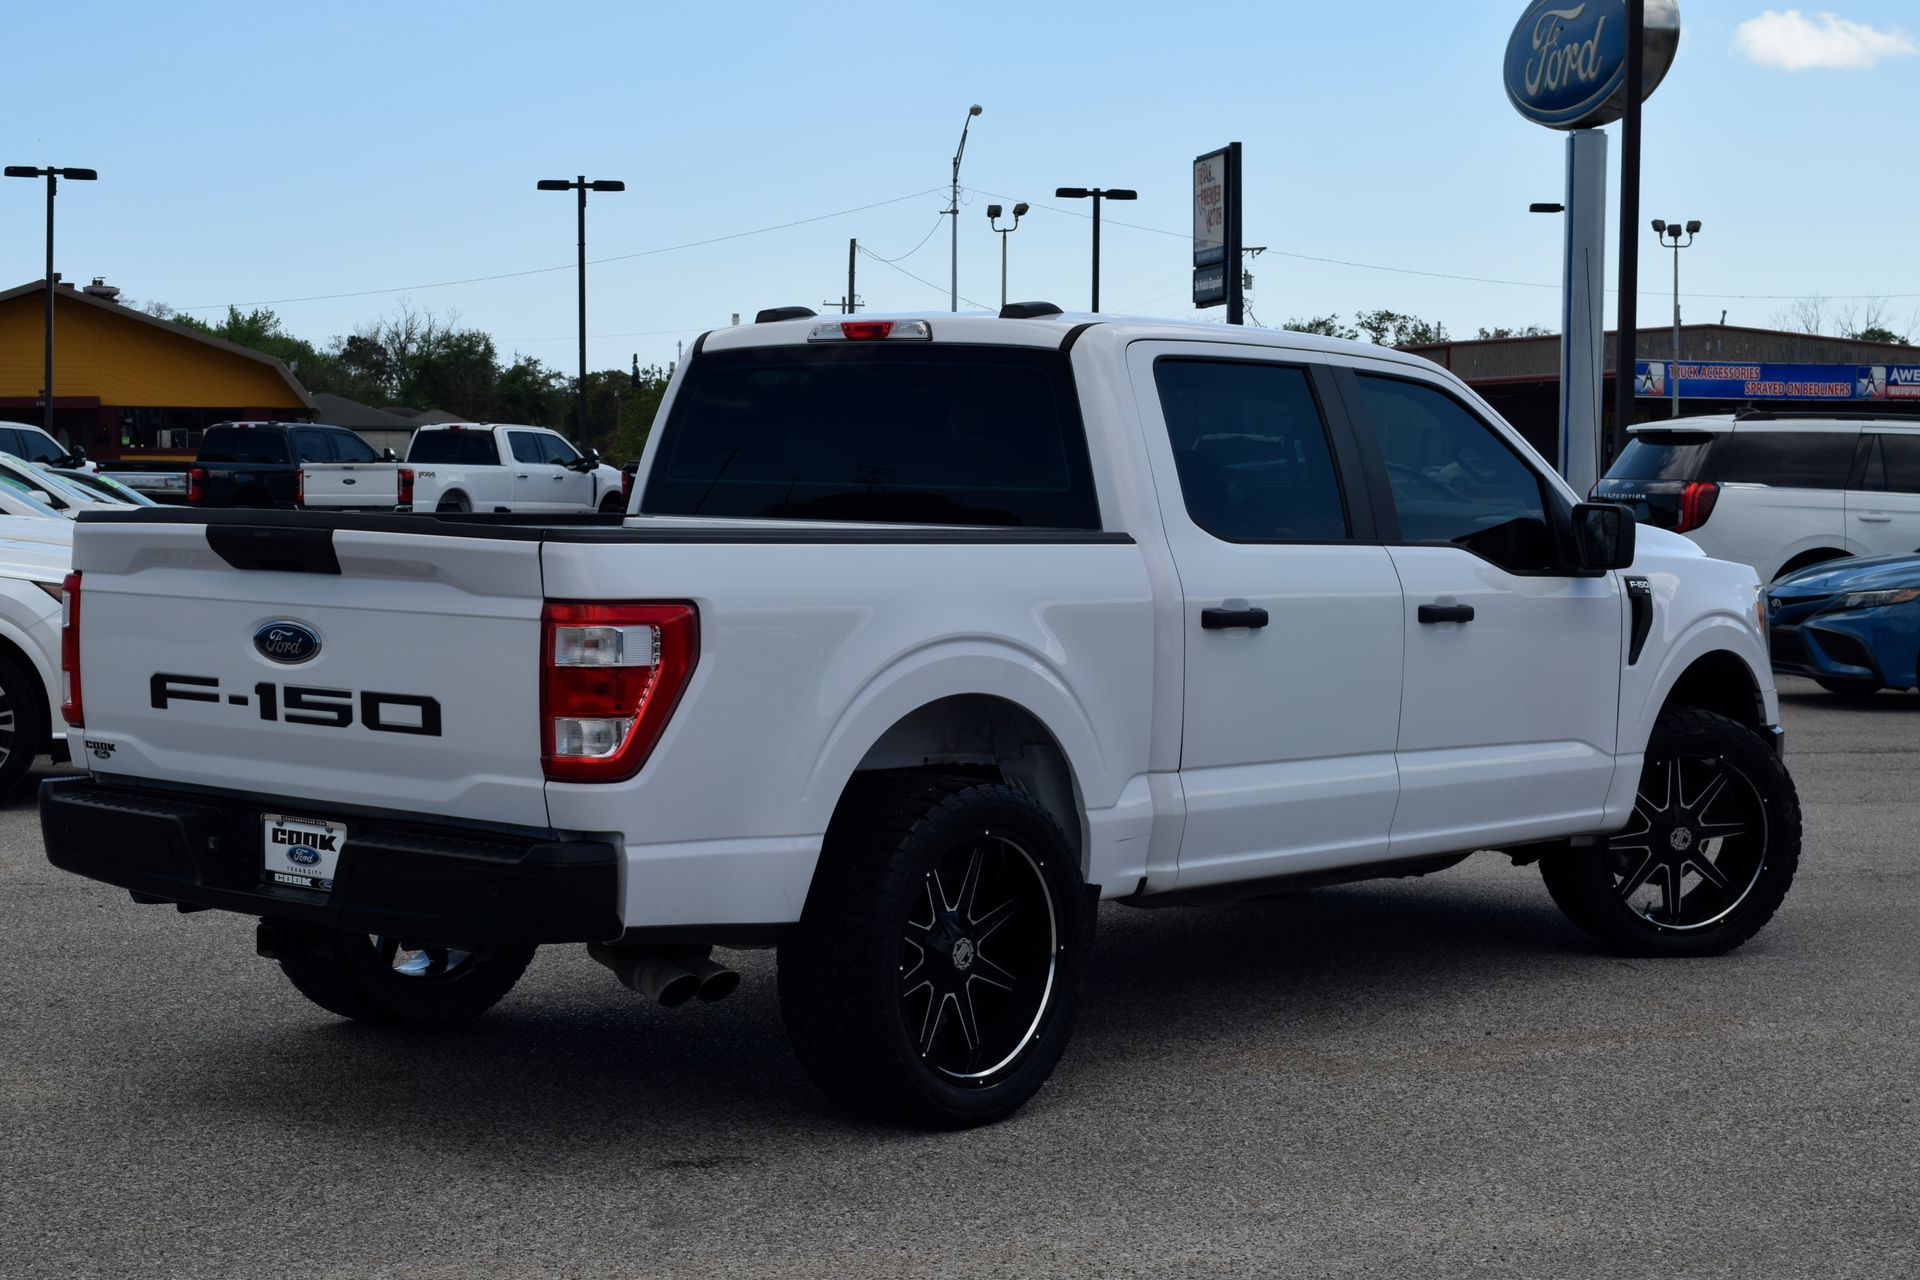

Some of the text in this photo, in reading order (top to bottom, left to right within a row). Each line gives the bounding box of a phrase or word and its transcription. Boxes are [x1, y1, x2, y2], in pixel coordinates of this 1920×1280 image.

[1525, 2, 1606, 97] Ford
[1701, 366, 1760, 380] ACCESSORIES
[1745, 382, 1850, 396] SPRAYED ON BEDLINERS
[1890, 387, 1910, 396] AUTO
[1629, 580, 1649, 588] F-150
[266, 629, 302, 654] Ford
[149, 672, 442, 737] F-150
[85, 740, 116, 752] COOK
[272, 828, 337, 852] COOK
[293, 849, 314, 863] Ford
[274, 873, 312, 886] COOK
